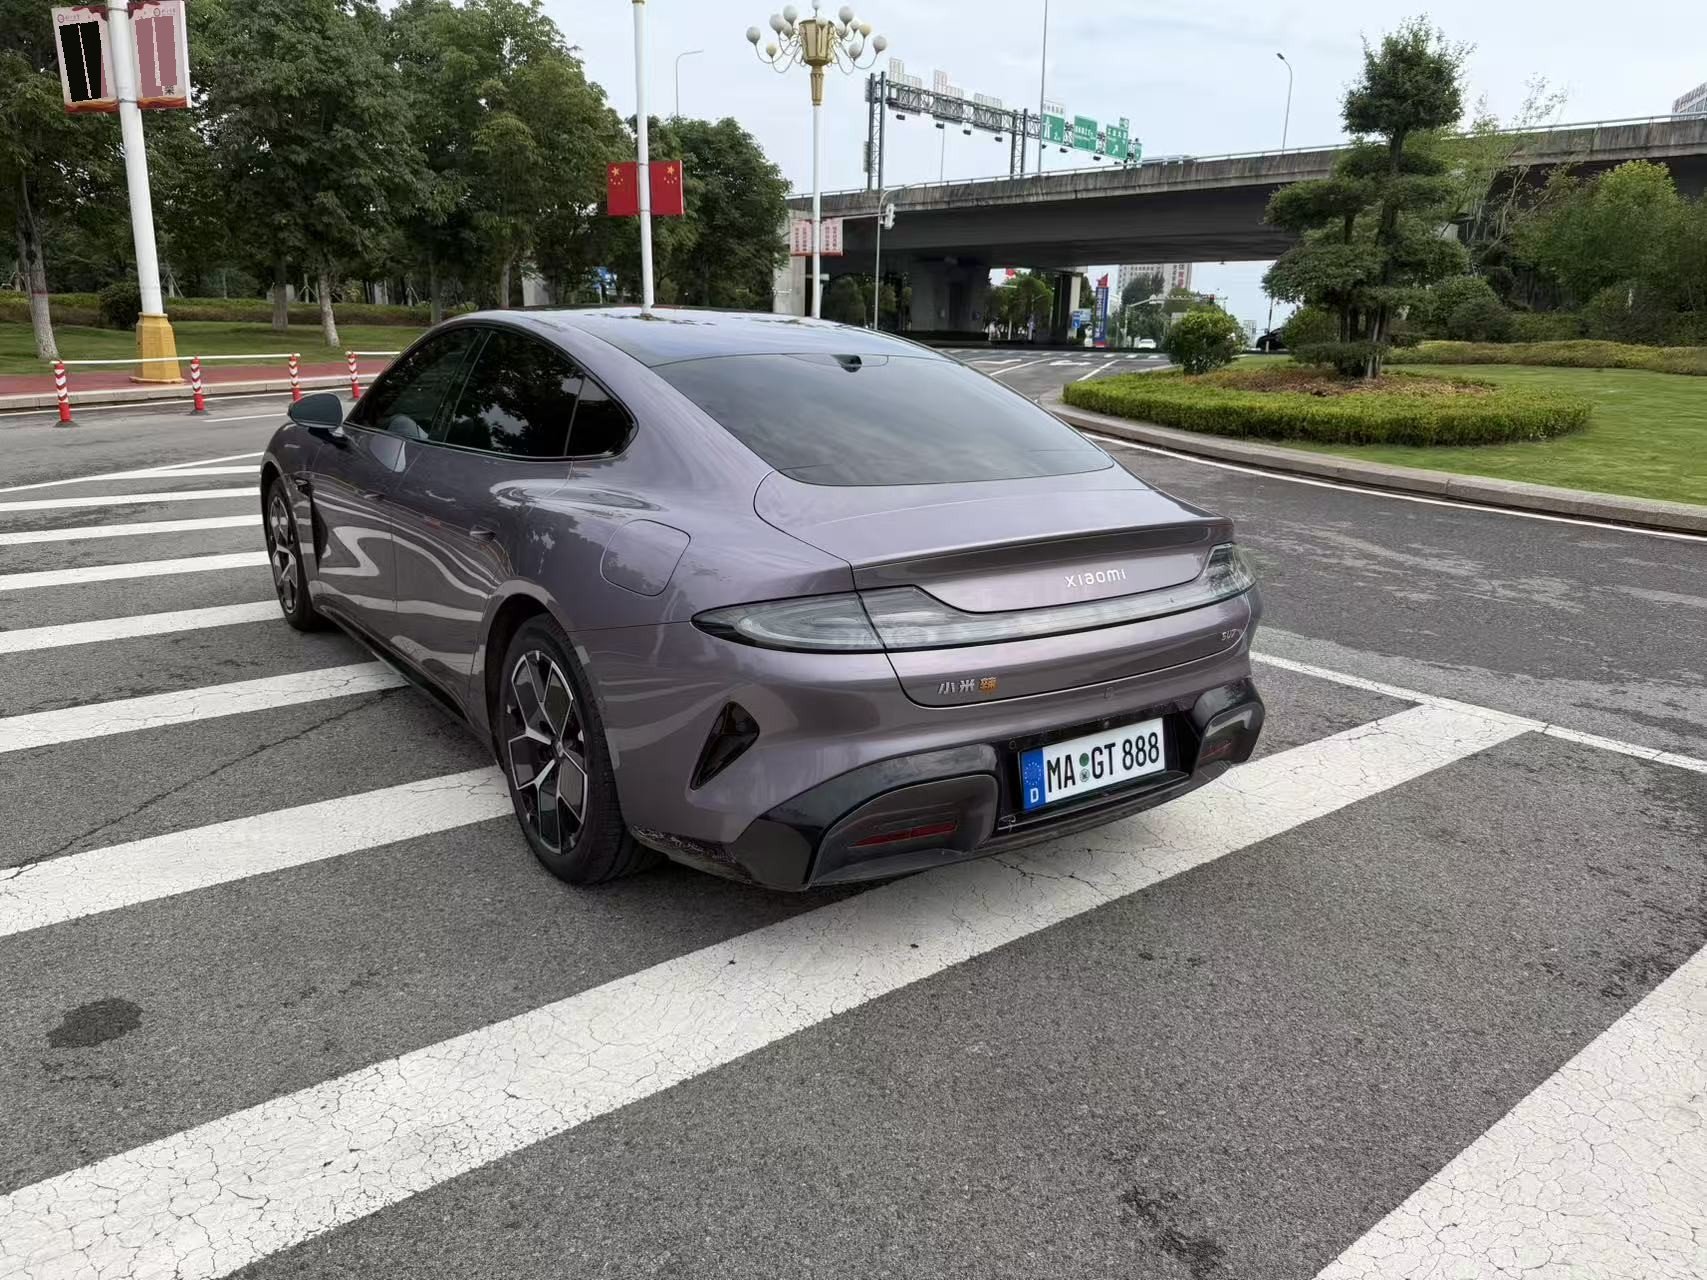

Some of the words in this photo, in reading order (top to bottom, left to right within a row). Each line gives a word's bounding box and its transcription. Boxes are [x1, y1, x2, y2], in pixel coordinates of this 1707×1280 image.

[1046, 754, 1076, 793] MA
[1091, 742, 1116, 780] GT
[1122, 731, 1160, 771] 888
[1029, 787, 1040, 804] D
